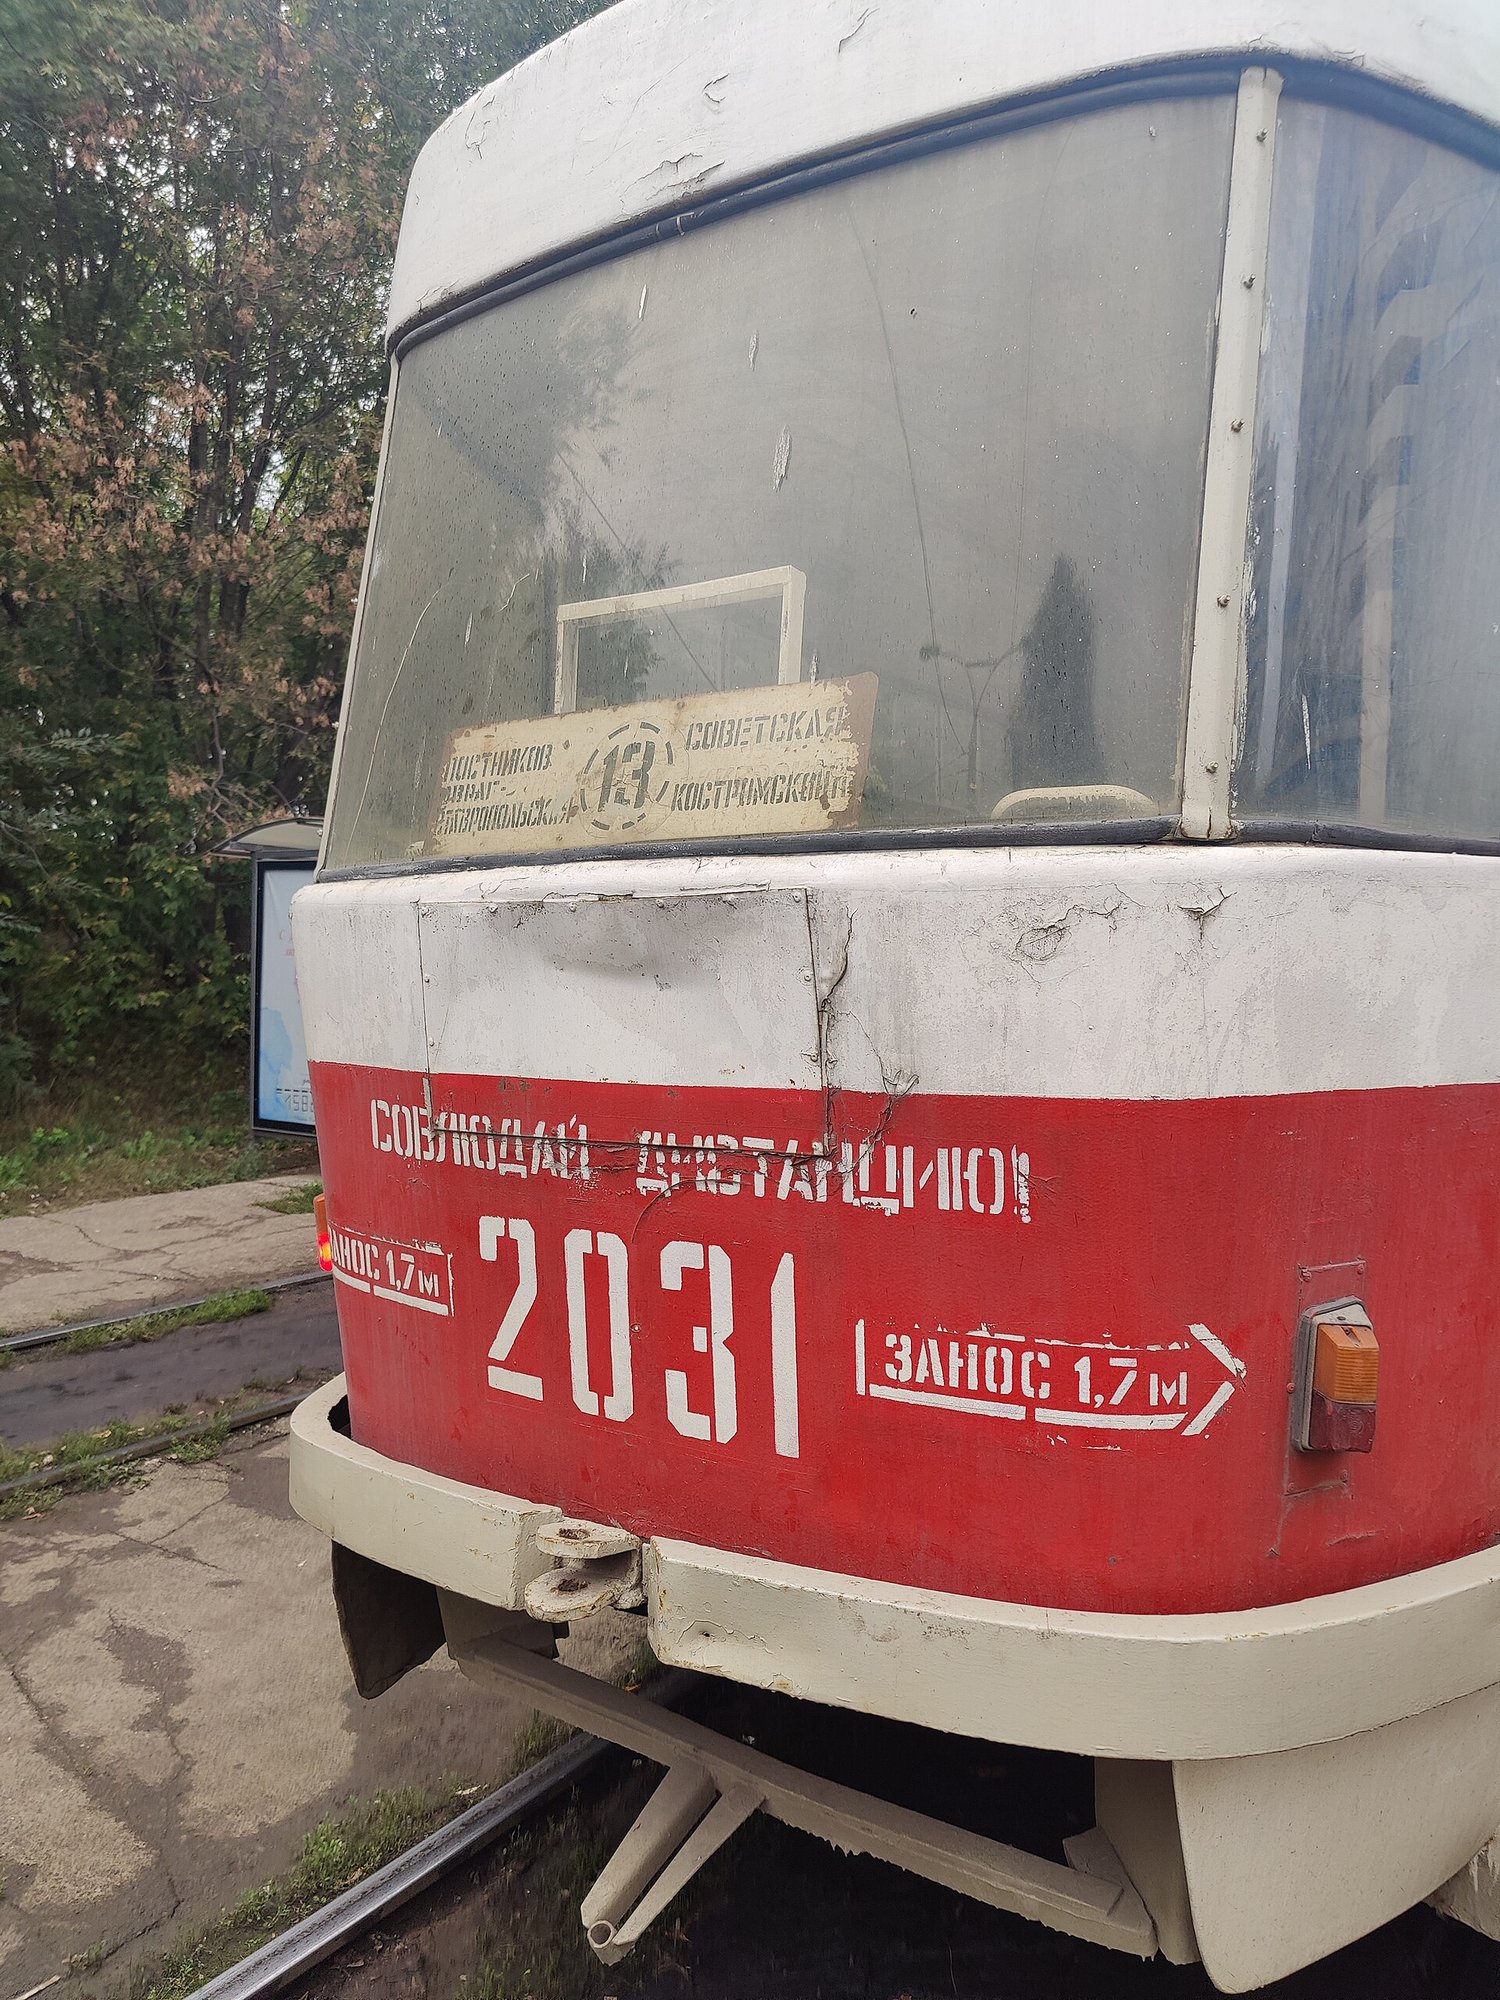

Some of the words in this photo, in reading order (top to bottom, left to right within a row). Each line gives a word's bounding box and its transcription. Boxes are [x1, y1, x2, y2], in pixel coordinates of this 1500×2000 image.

[442, 743, 554, 783] ПОСТНИКОВ
[685, 705, 850, 751] СОВЕТСКАЯ
[597, 740, 656, 813] 13
[370, 1098, 591, 1182] СОБЛЮДАЙ
[636, 1130, 1032, 1224] ДИСТАНЦИЮ!
[328, 1224, 380, 1281] АНОС
[385, 1249, 415, 1292] 1,7
[479, 1214, 800, 1459] 2031
[885, 1333, 1051, 1400] ЗАНОС
[1073, 1355, 1138, 1409] 1,7
